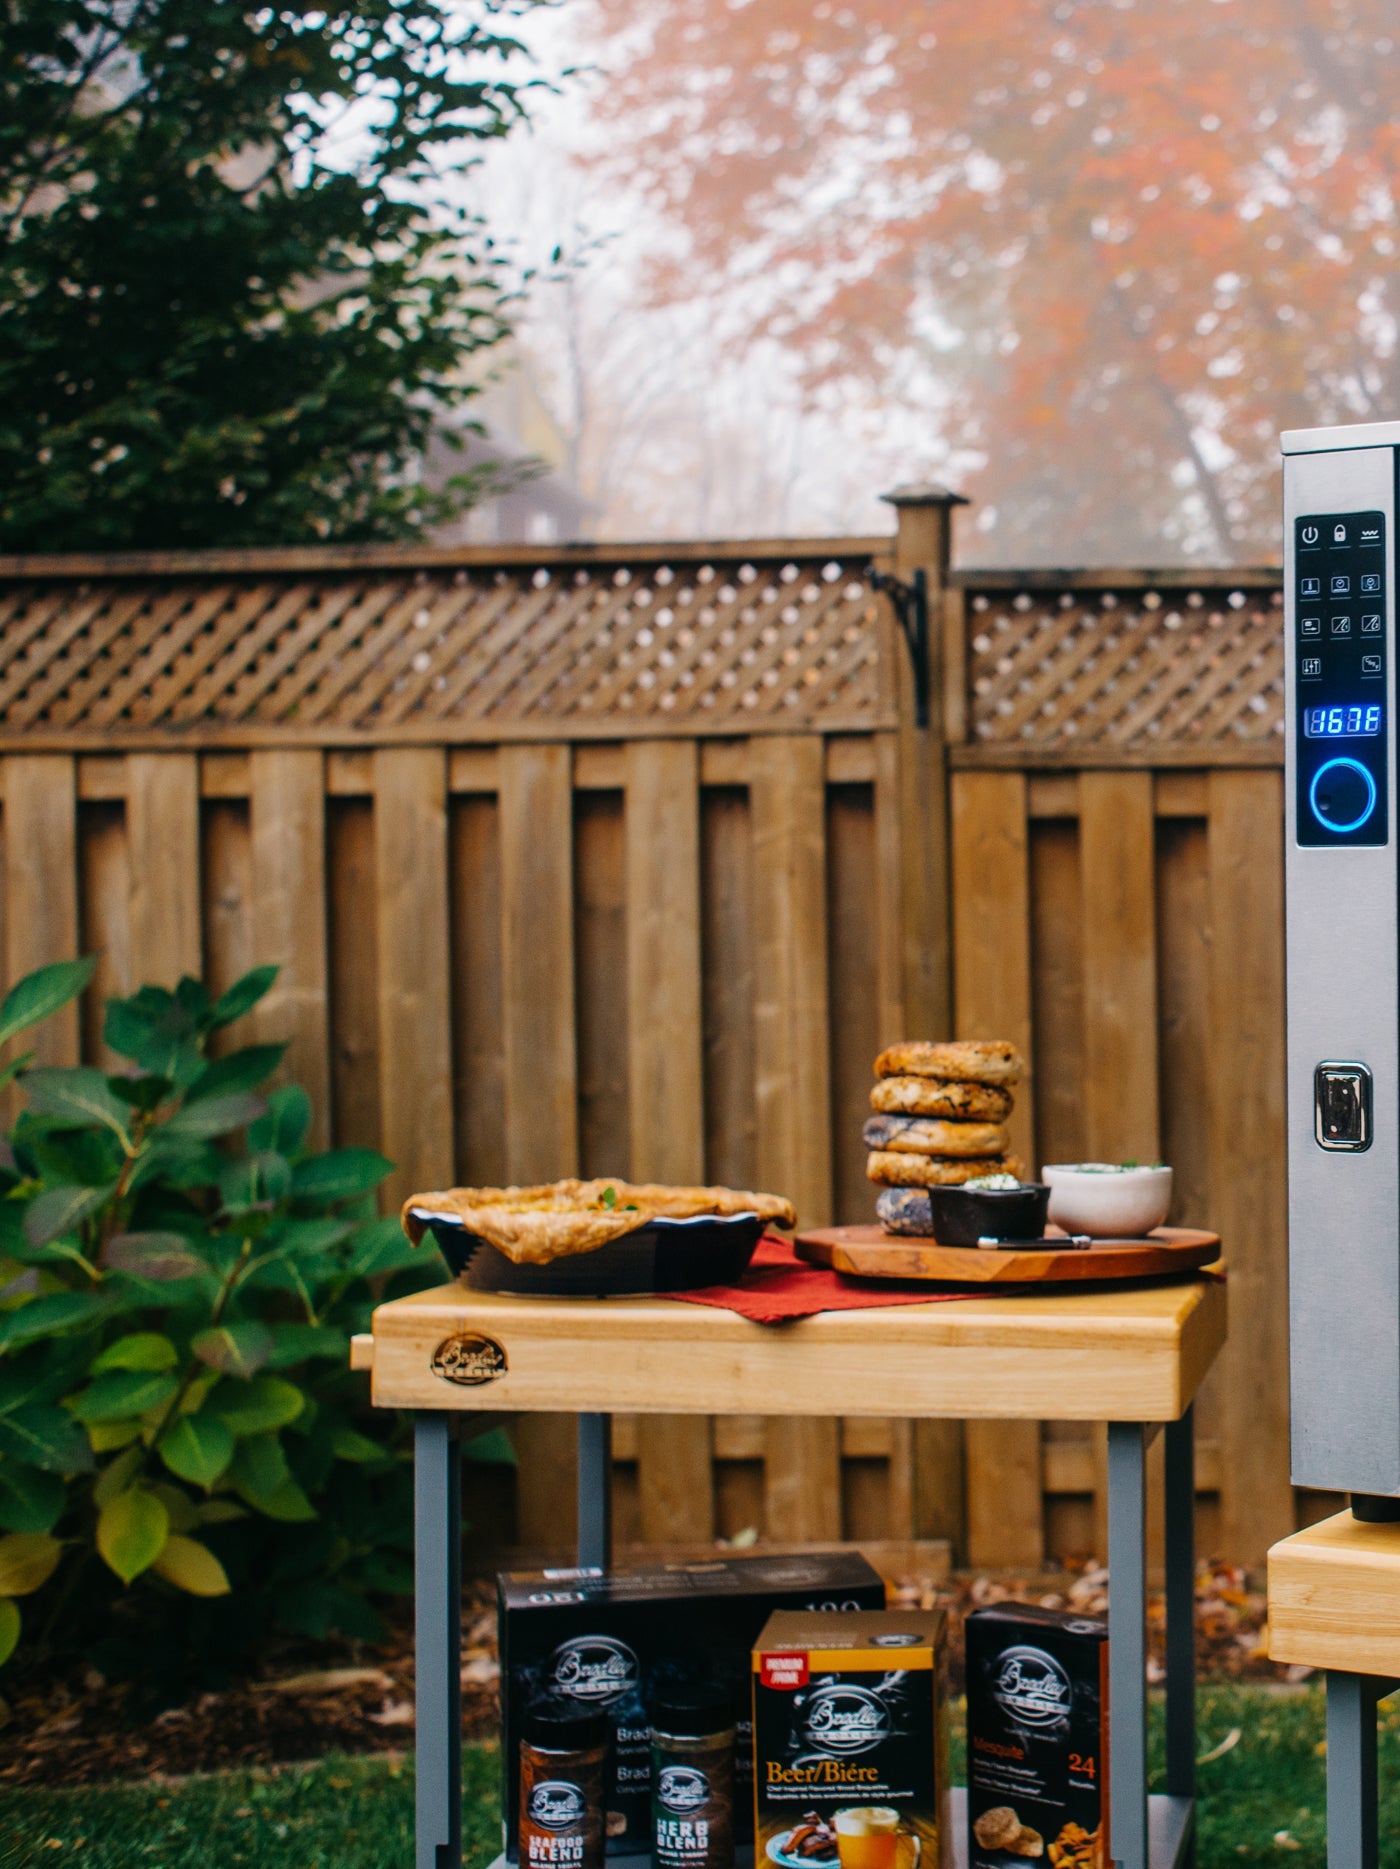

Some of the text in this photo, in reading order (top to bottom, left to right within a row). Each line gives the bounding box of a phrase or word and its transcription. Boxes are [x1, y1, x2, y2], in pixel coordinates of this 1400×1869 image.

[803, 1699, 886, 1731] Bradley
[1069, 1754, 1096, 1779] 24
[657, 1819, 708, 1836] HERB
[528, 1835, 583, 1848] SEAFOOD
[656, 1834, 709, 1849] BLEND
[528, 1846, 583, 1861] BLEND
